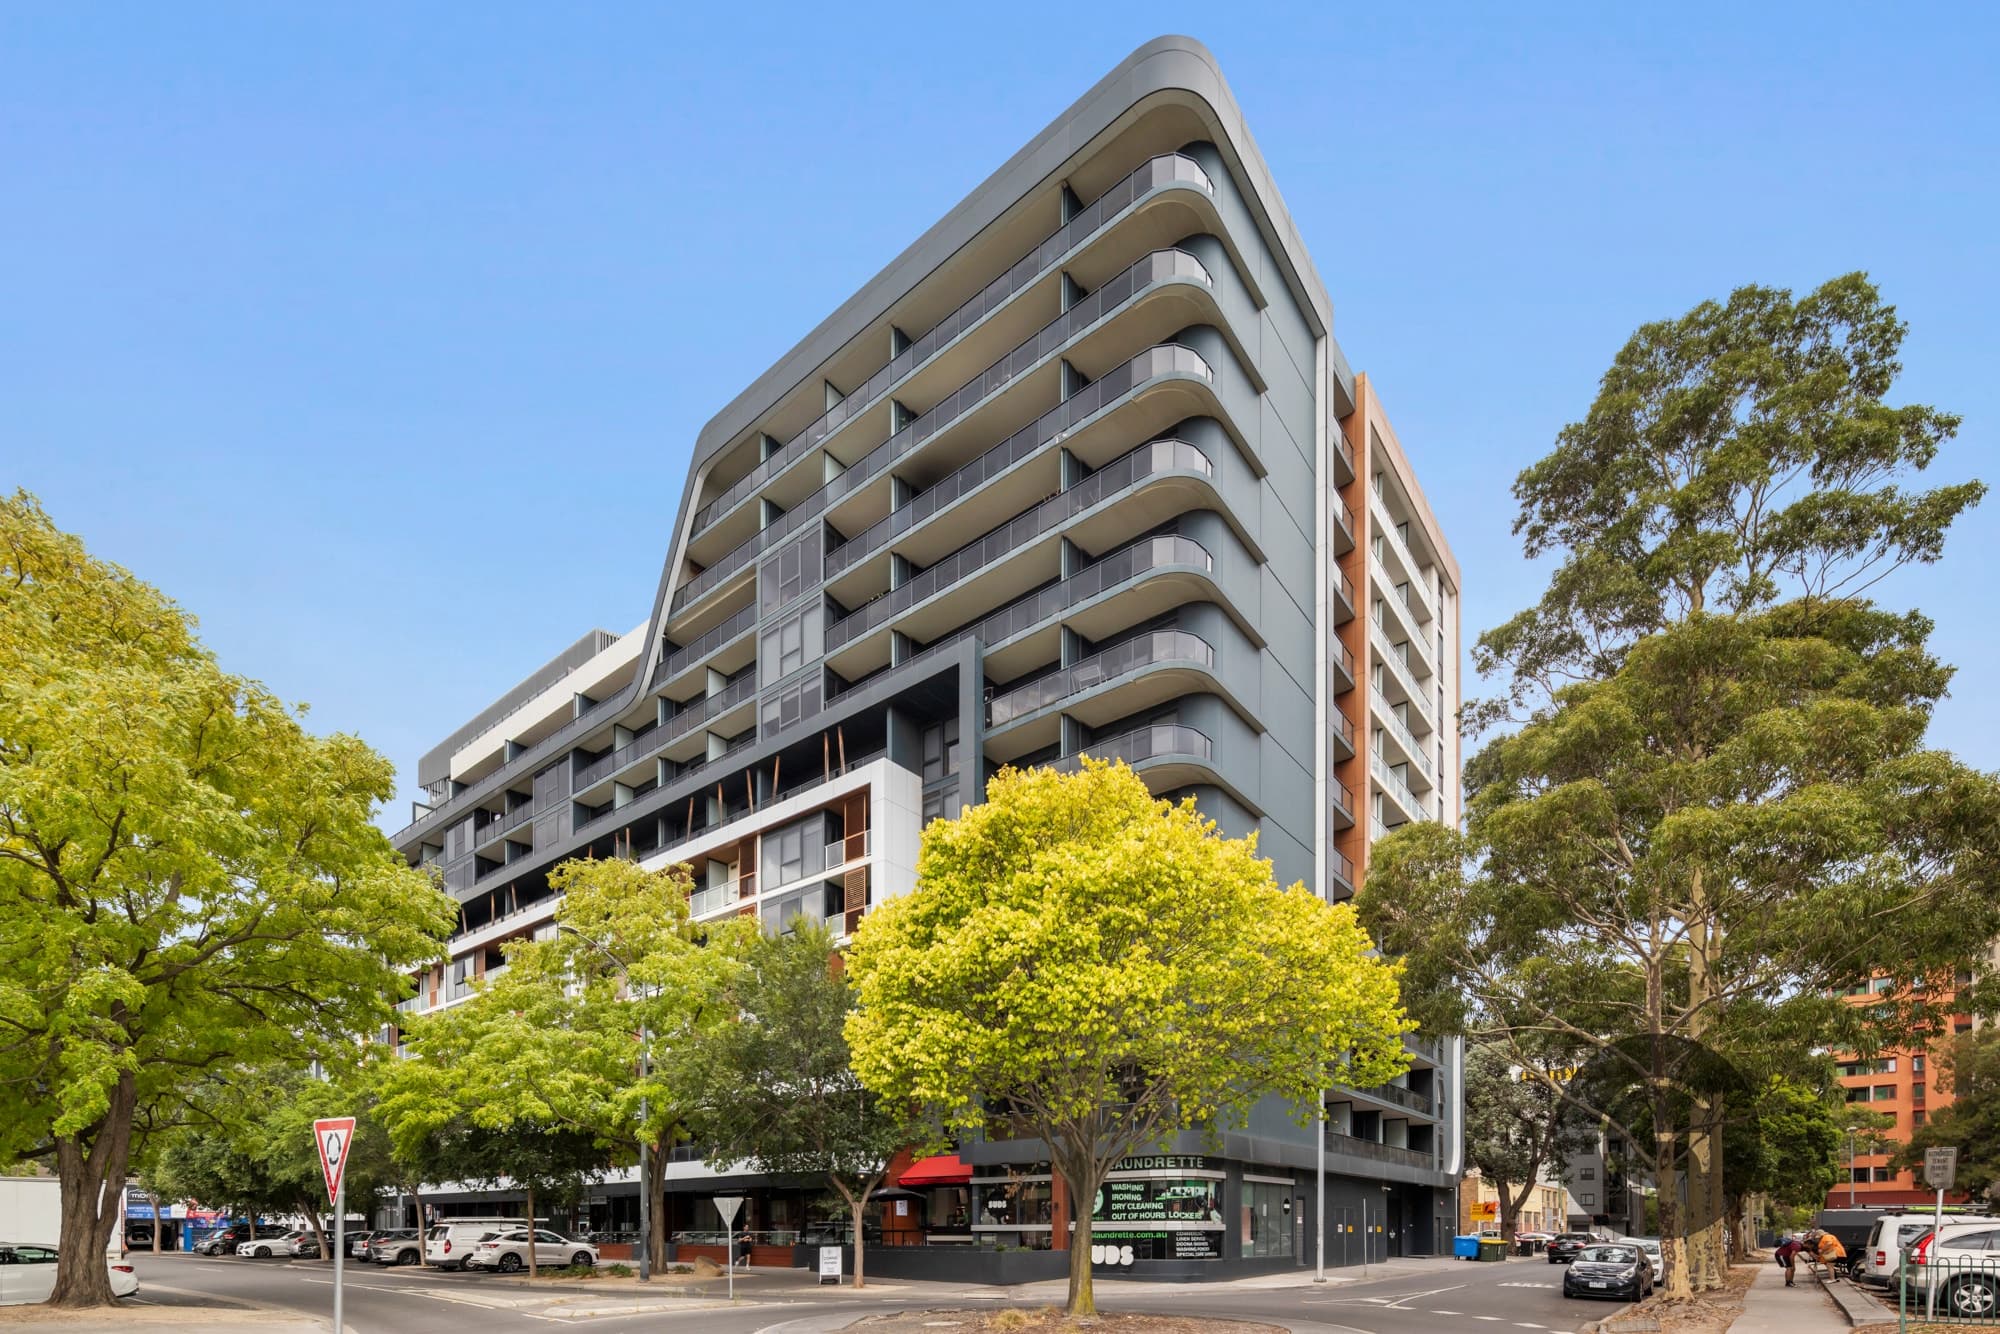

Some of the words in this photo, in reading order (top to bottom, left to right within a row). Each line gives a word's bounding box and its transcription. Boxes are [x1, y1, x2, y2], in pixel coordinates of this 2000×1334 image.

[1111, 1157, 1204, 1169] AUNDRETTE
[1112, 1183, 1144, 1191] WASHING
[988, 1200, 1007, 1208] SUDS
[1127, 1202, 1164, 1210] CLEANING
[1112, 1212, 1127, 1220] OUT
[1127, 1212, 1139, 1220] OF
[1092, 1231, 1167, 1239] laundrette.com.au
[1091, 1245, 1134, 1266] UDS
